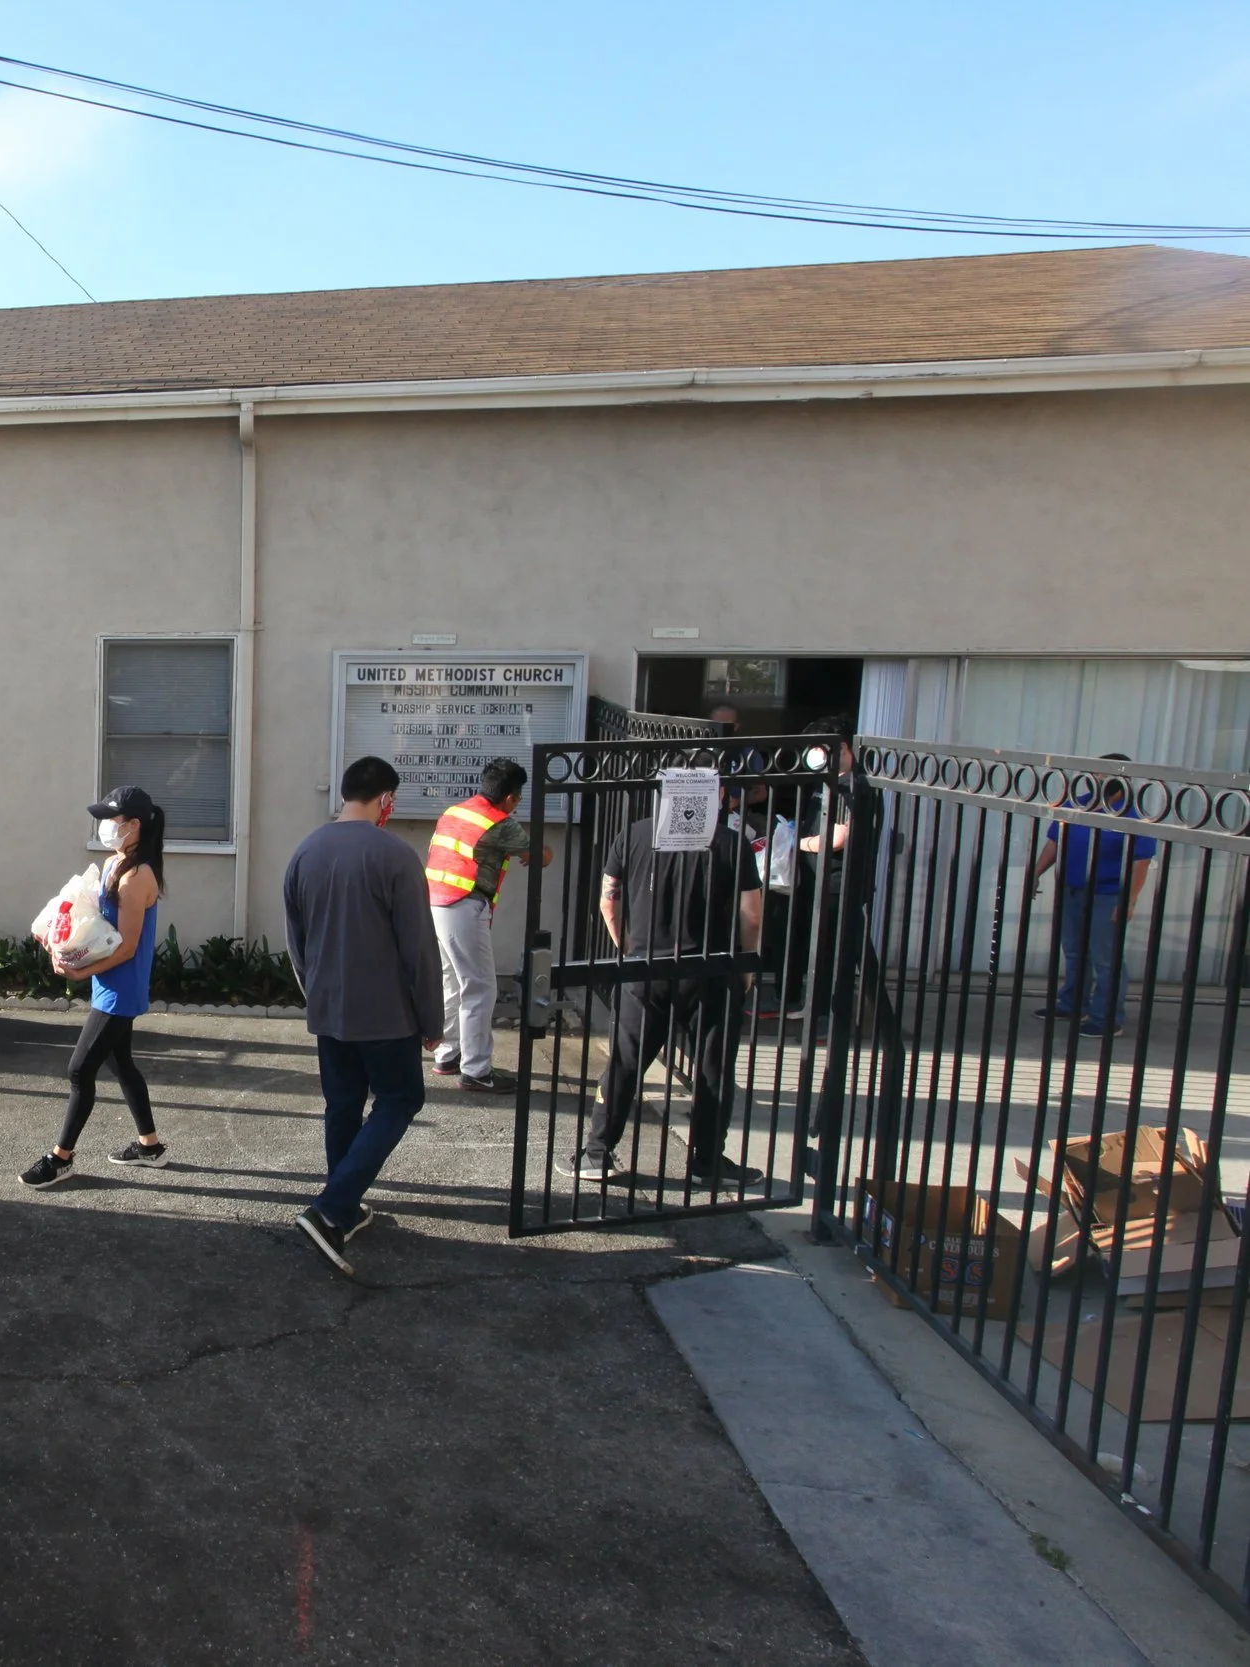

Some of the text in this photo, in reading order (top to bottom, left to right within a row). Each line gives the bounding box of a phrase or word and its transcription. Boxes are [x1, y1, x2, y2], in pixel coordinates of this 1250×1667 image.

[358, 668, 563, 682] UNITED METHODIST CHURCH
[394, 684, 519, 696] MISSION COMMUNITY
[392, 704, 430, 714] WORSHIP
[436, 704, 476, 714] SERVICE
[437, 724, 458, 735] WITH
[467, 724, 479, 735] US
[484, 724, 520, 736] ONLINE
[434, 738, 481, 749] VIA ZOOM
[422, 786, 480, 797] FOR UPDAT
